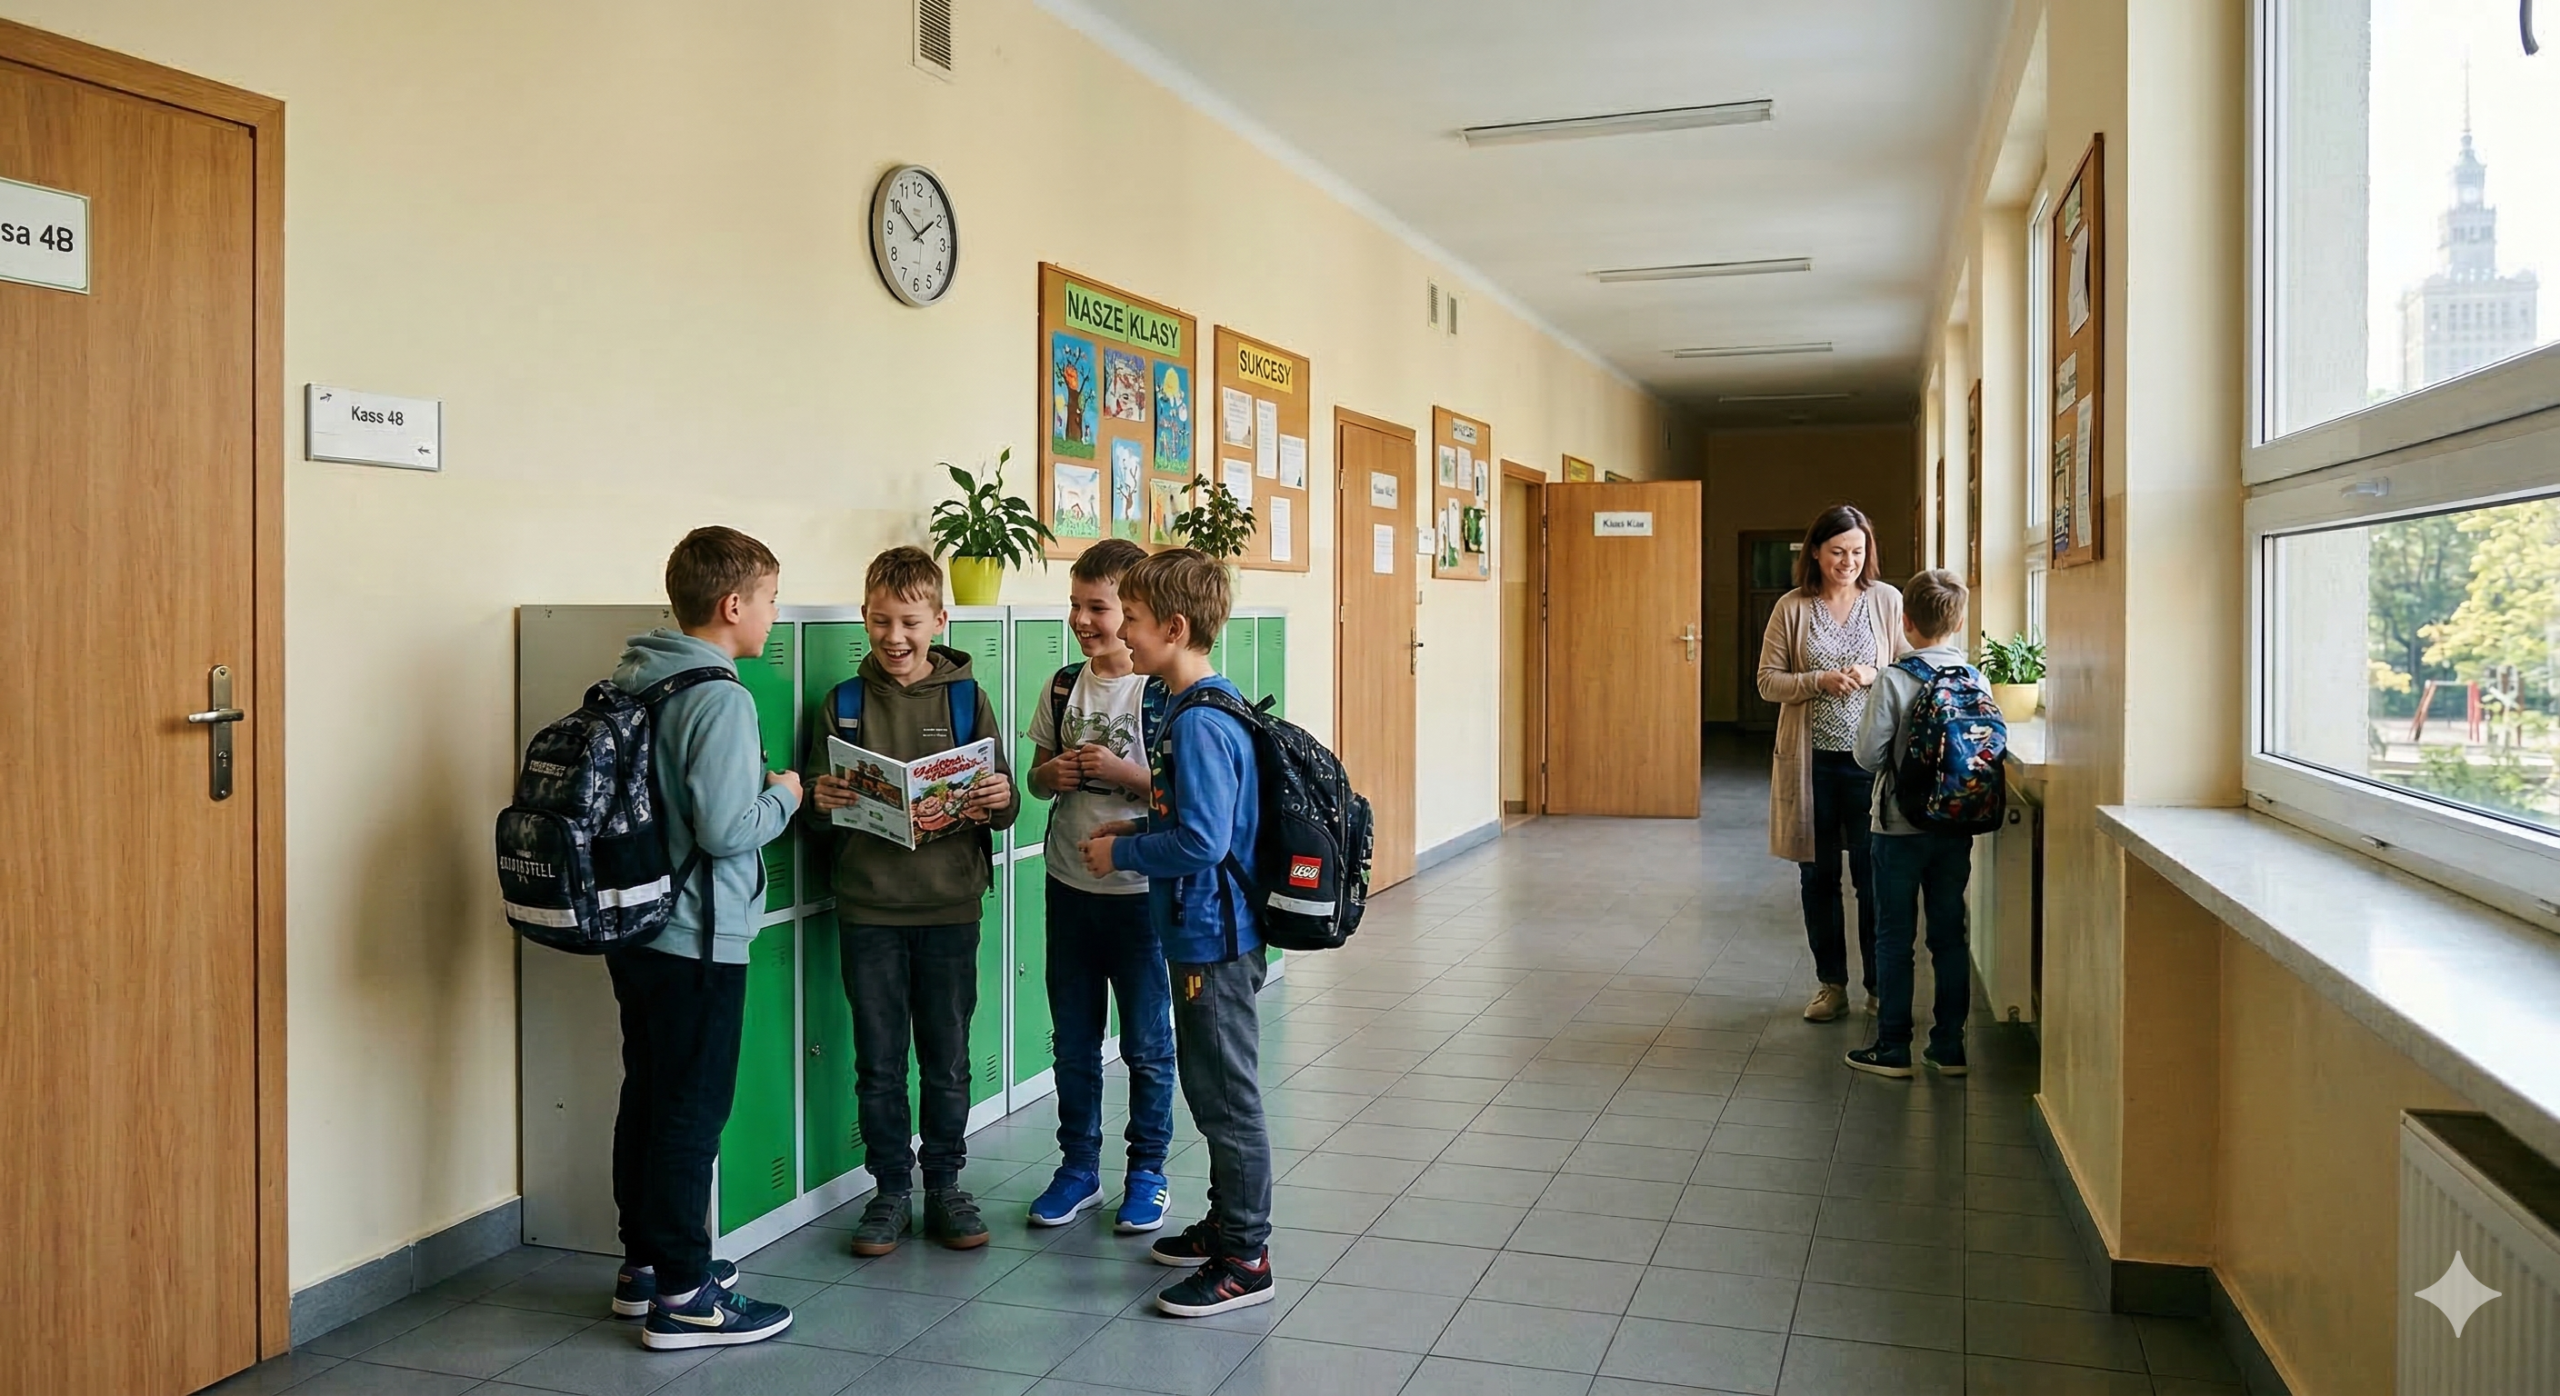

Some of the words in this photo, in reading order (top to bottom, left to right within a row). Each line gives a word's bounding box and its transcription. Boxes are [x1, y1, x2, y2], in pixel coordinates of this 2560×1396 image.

[899, 183, 909, 199] 11
[912, 181, 923, 198] 12
[890, 198, 902, 215] 10
[928, 195, 933, 208] 1
[887, 220, 894, 235] 9
[936, 214, 943, 229] 2
[1, 223, 30, 246] sa
[39, 225, 74, 252] 48
[939, 238, 946, 252] 3
[890, 246, 898, 261] 8
[901, 266, 908, 281] 7
[935, 260, 943, 275] 4
[913, 277, 920, 292] 6
[926, 274, 932, 289] 5
[1067, 290, 1124, 334] NASZE
[1129, 311, 1179, 350] KLASY
[1239, 349, 1292, 386] SUKCESY
[351, 405, 384, 424] Kass
[388, 410, 404, 426] 48
[1292, 865, 1319, 878] LEGO
